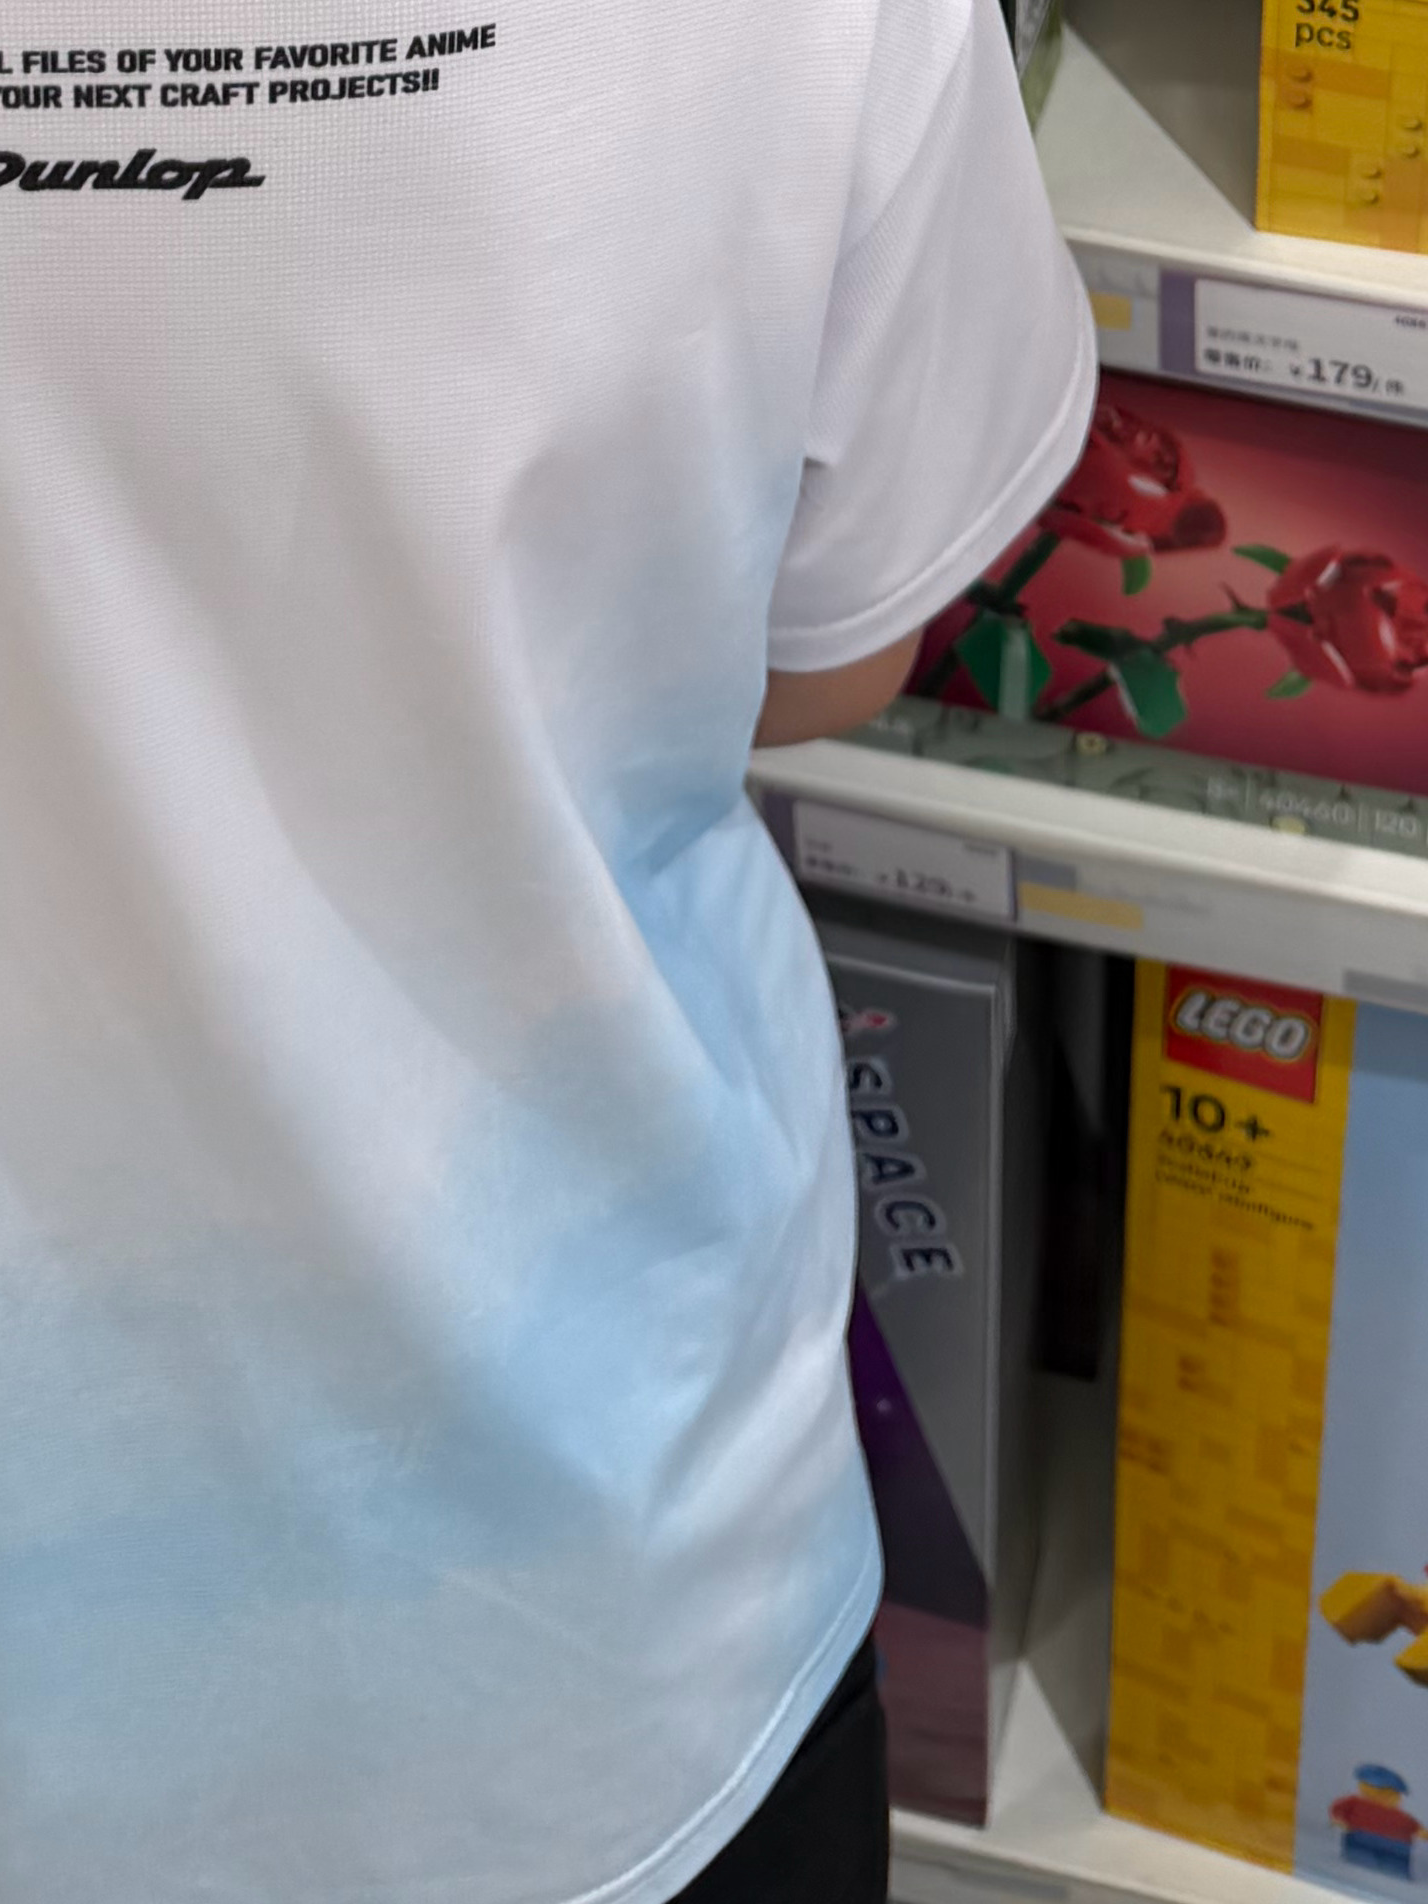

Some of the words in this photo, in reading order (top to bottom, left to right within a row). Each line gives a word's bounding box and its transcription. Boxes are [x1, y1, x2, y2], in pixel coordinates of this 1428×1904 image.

[22, 48, 107, 75] FILES
[117, 48, 157, 75] OF
[164, 46, 242, 74] YOUR
[253, 38, 397, 71] FAVORITE
[405, 22, 497, 61] ANIME
[1296, 23, 1351, 51] pcs
[72, 83, 151, 109] NEXT
[159, 81, 259, 109] CRAFT
[267, 68, 441, 105] PROJECTS!!
[1176, 992, 1308, 1059] LEGO
[1160, 1084, 1270, 1143] 10+
